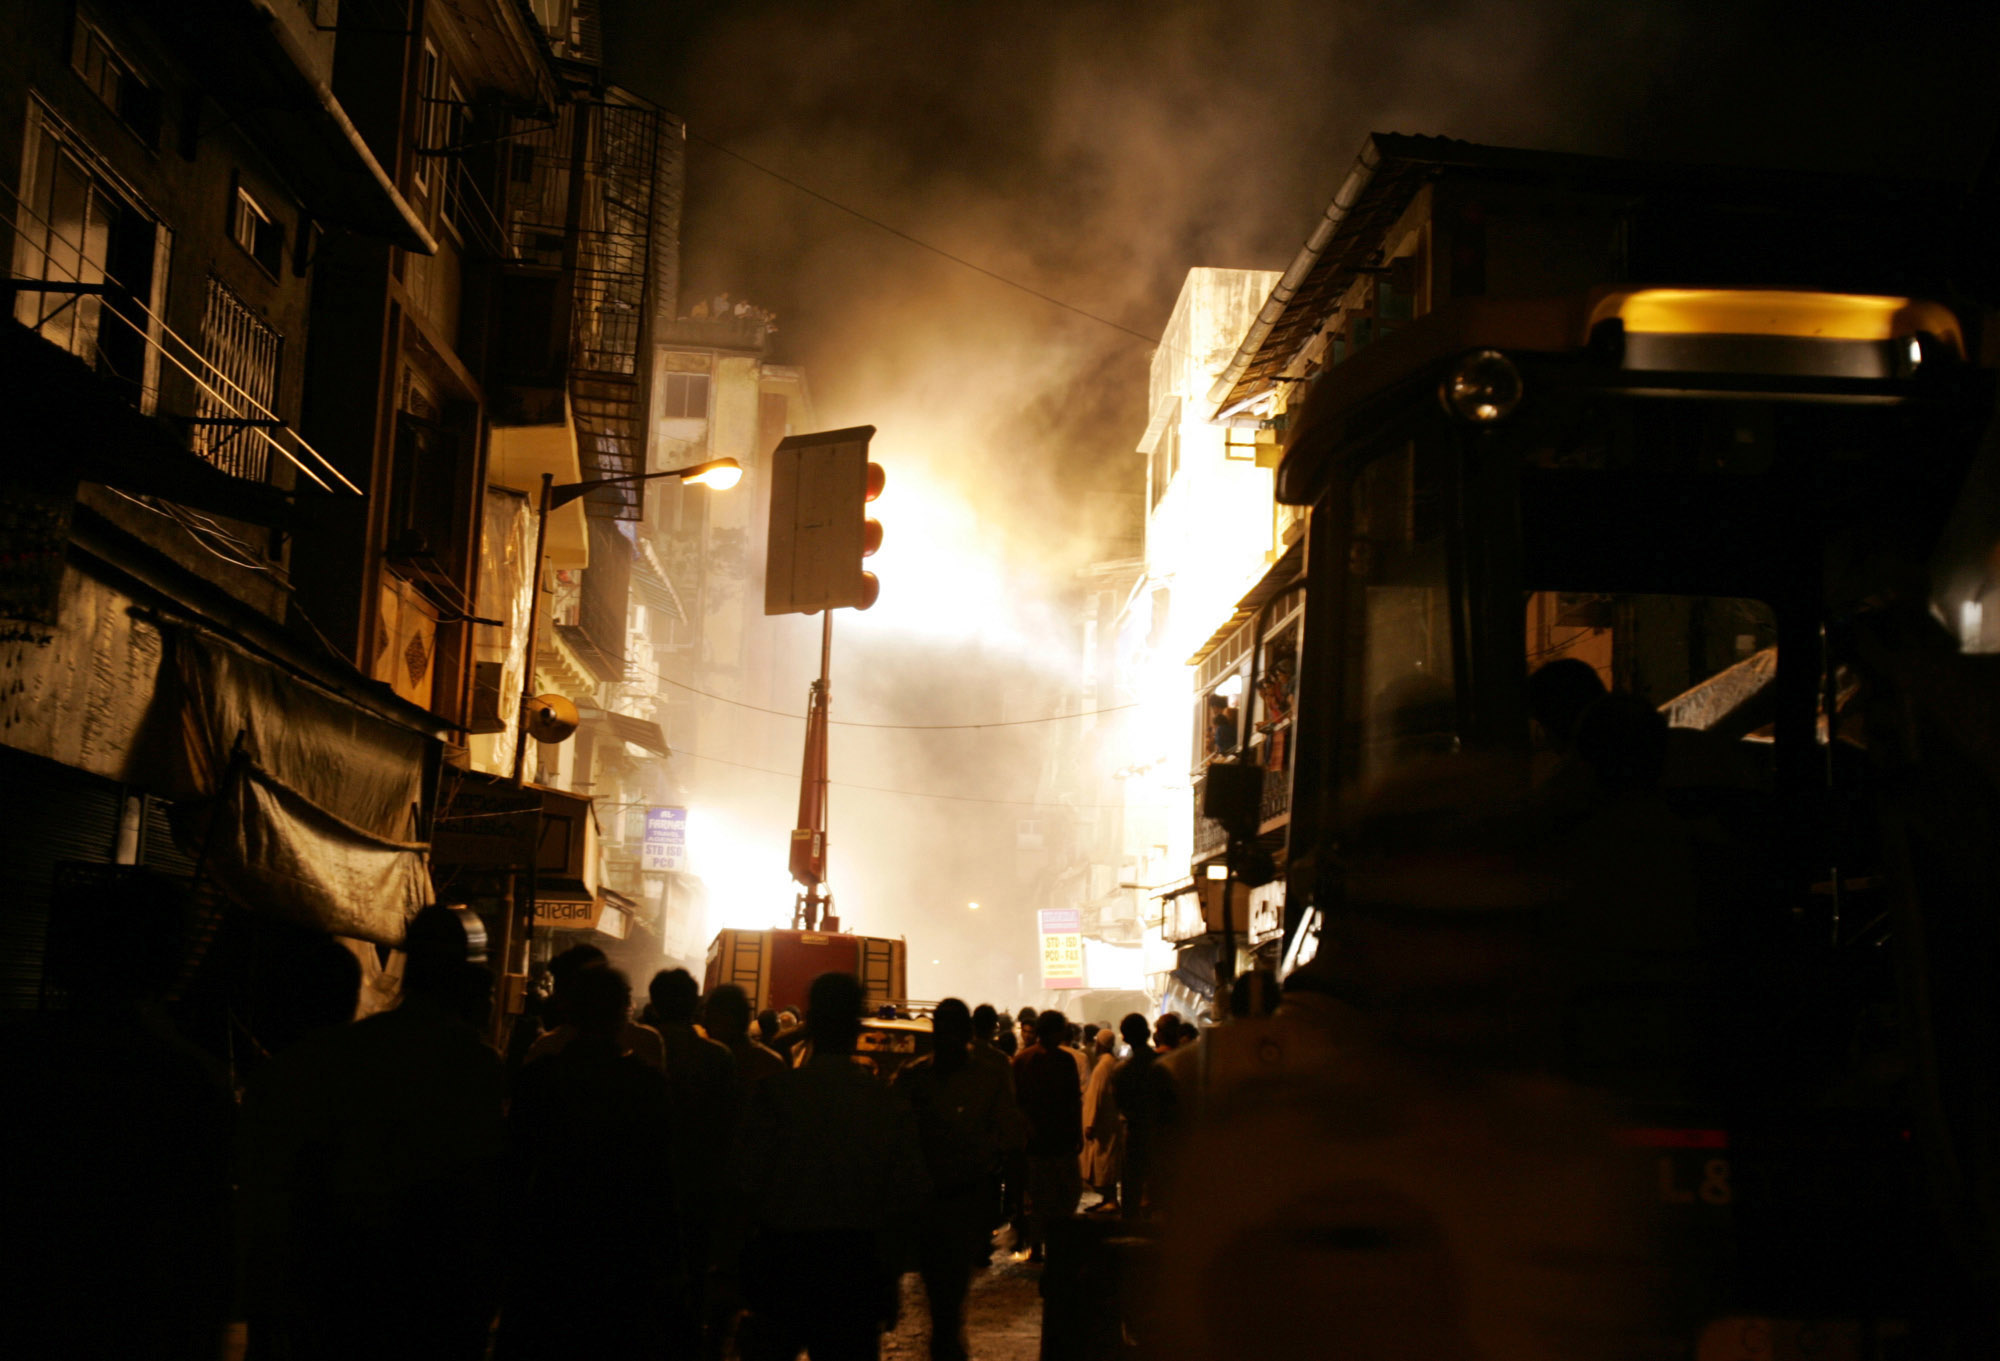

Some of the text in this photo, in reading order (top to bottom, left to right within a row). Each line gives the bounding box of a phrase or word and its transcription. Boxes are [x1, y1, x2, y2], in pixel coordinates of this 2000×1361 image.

[646, 844, 682, 857] STD ISD
[652, 857, 674, 868] PCO
[1045, 936, 1059, 948] STD
[1065, 936, 1077, 948] ISD
[1045, 949, 1059, 961] PCO
